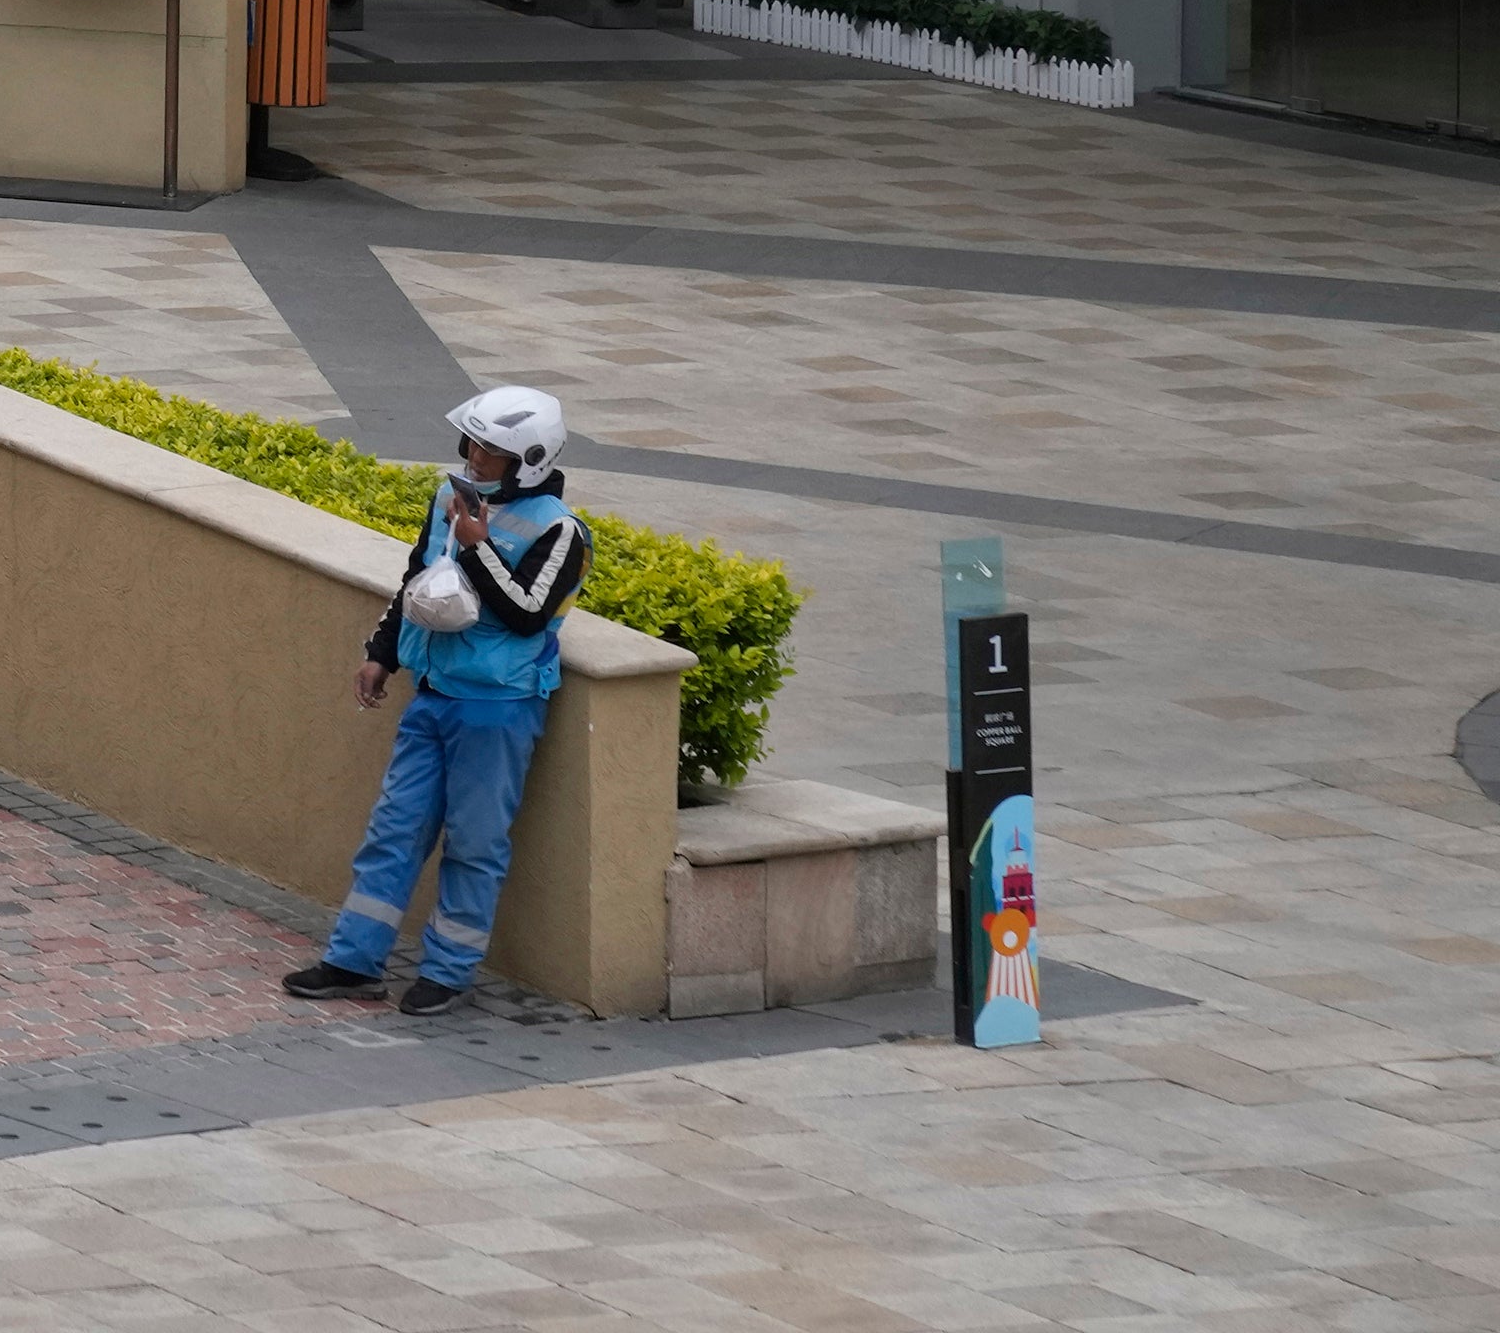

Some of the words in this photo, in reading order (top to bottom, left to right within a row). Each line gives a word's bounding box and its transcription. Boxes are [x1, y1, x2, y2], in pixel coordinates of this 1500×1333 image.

[988, 634, 1008, 674] 1
[975, 726, 1005, 739] COPPER
[984, 735, 1015, 748] SQUARE
